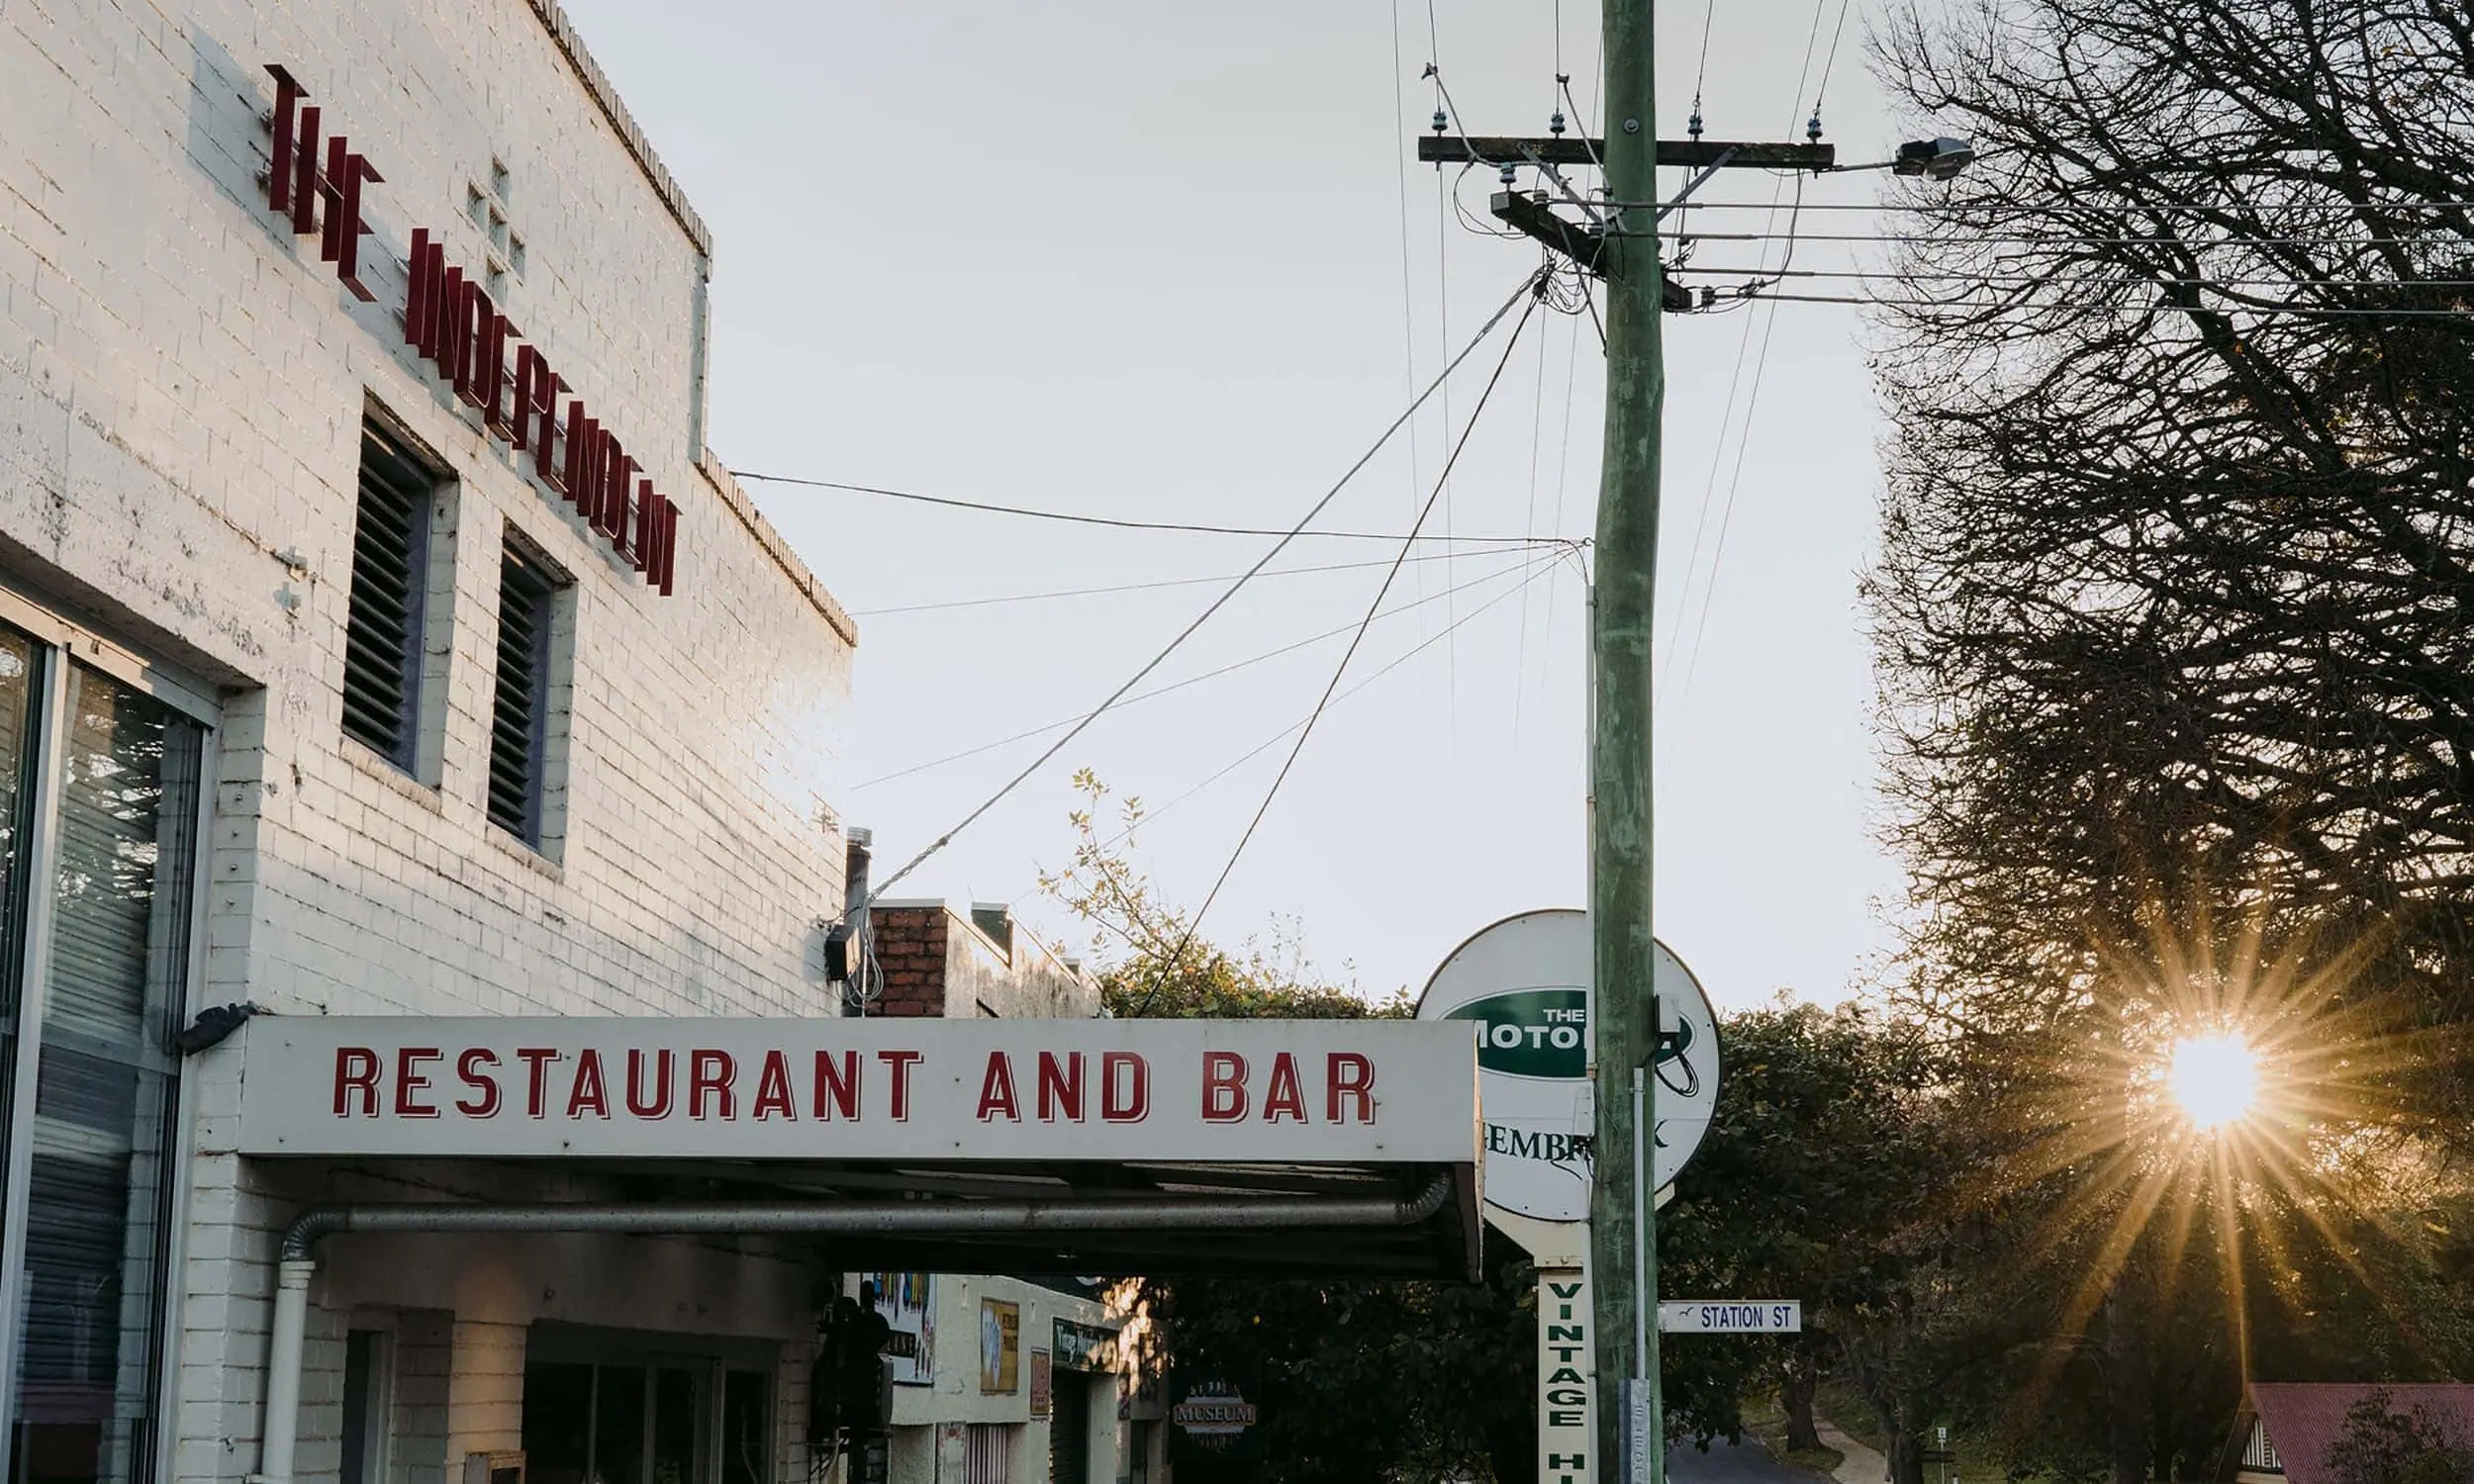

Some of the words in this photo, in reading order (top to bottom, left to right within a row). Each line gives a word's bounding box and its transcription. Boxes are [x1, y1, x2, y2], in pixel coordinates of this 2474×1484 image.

[262, 64, 386, 302] THE
[404, 227, 684, 597] INDEPENDENT
[1543, 1008, 1585, 1022] THE
[333, 1047, 923, 1123] RESTAURANT
[976, 1051, 1151, 1123] AND
[1201, 1051, 1377, 1125] BAR
[1701, 1306, 1763, 1328] STATION
[1773, 1306, 1791, 1328] ST
[1546, 1282, 1586, 1427] VINTAGE
[1177, 1406, 1253, 1422] MUSEUM
